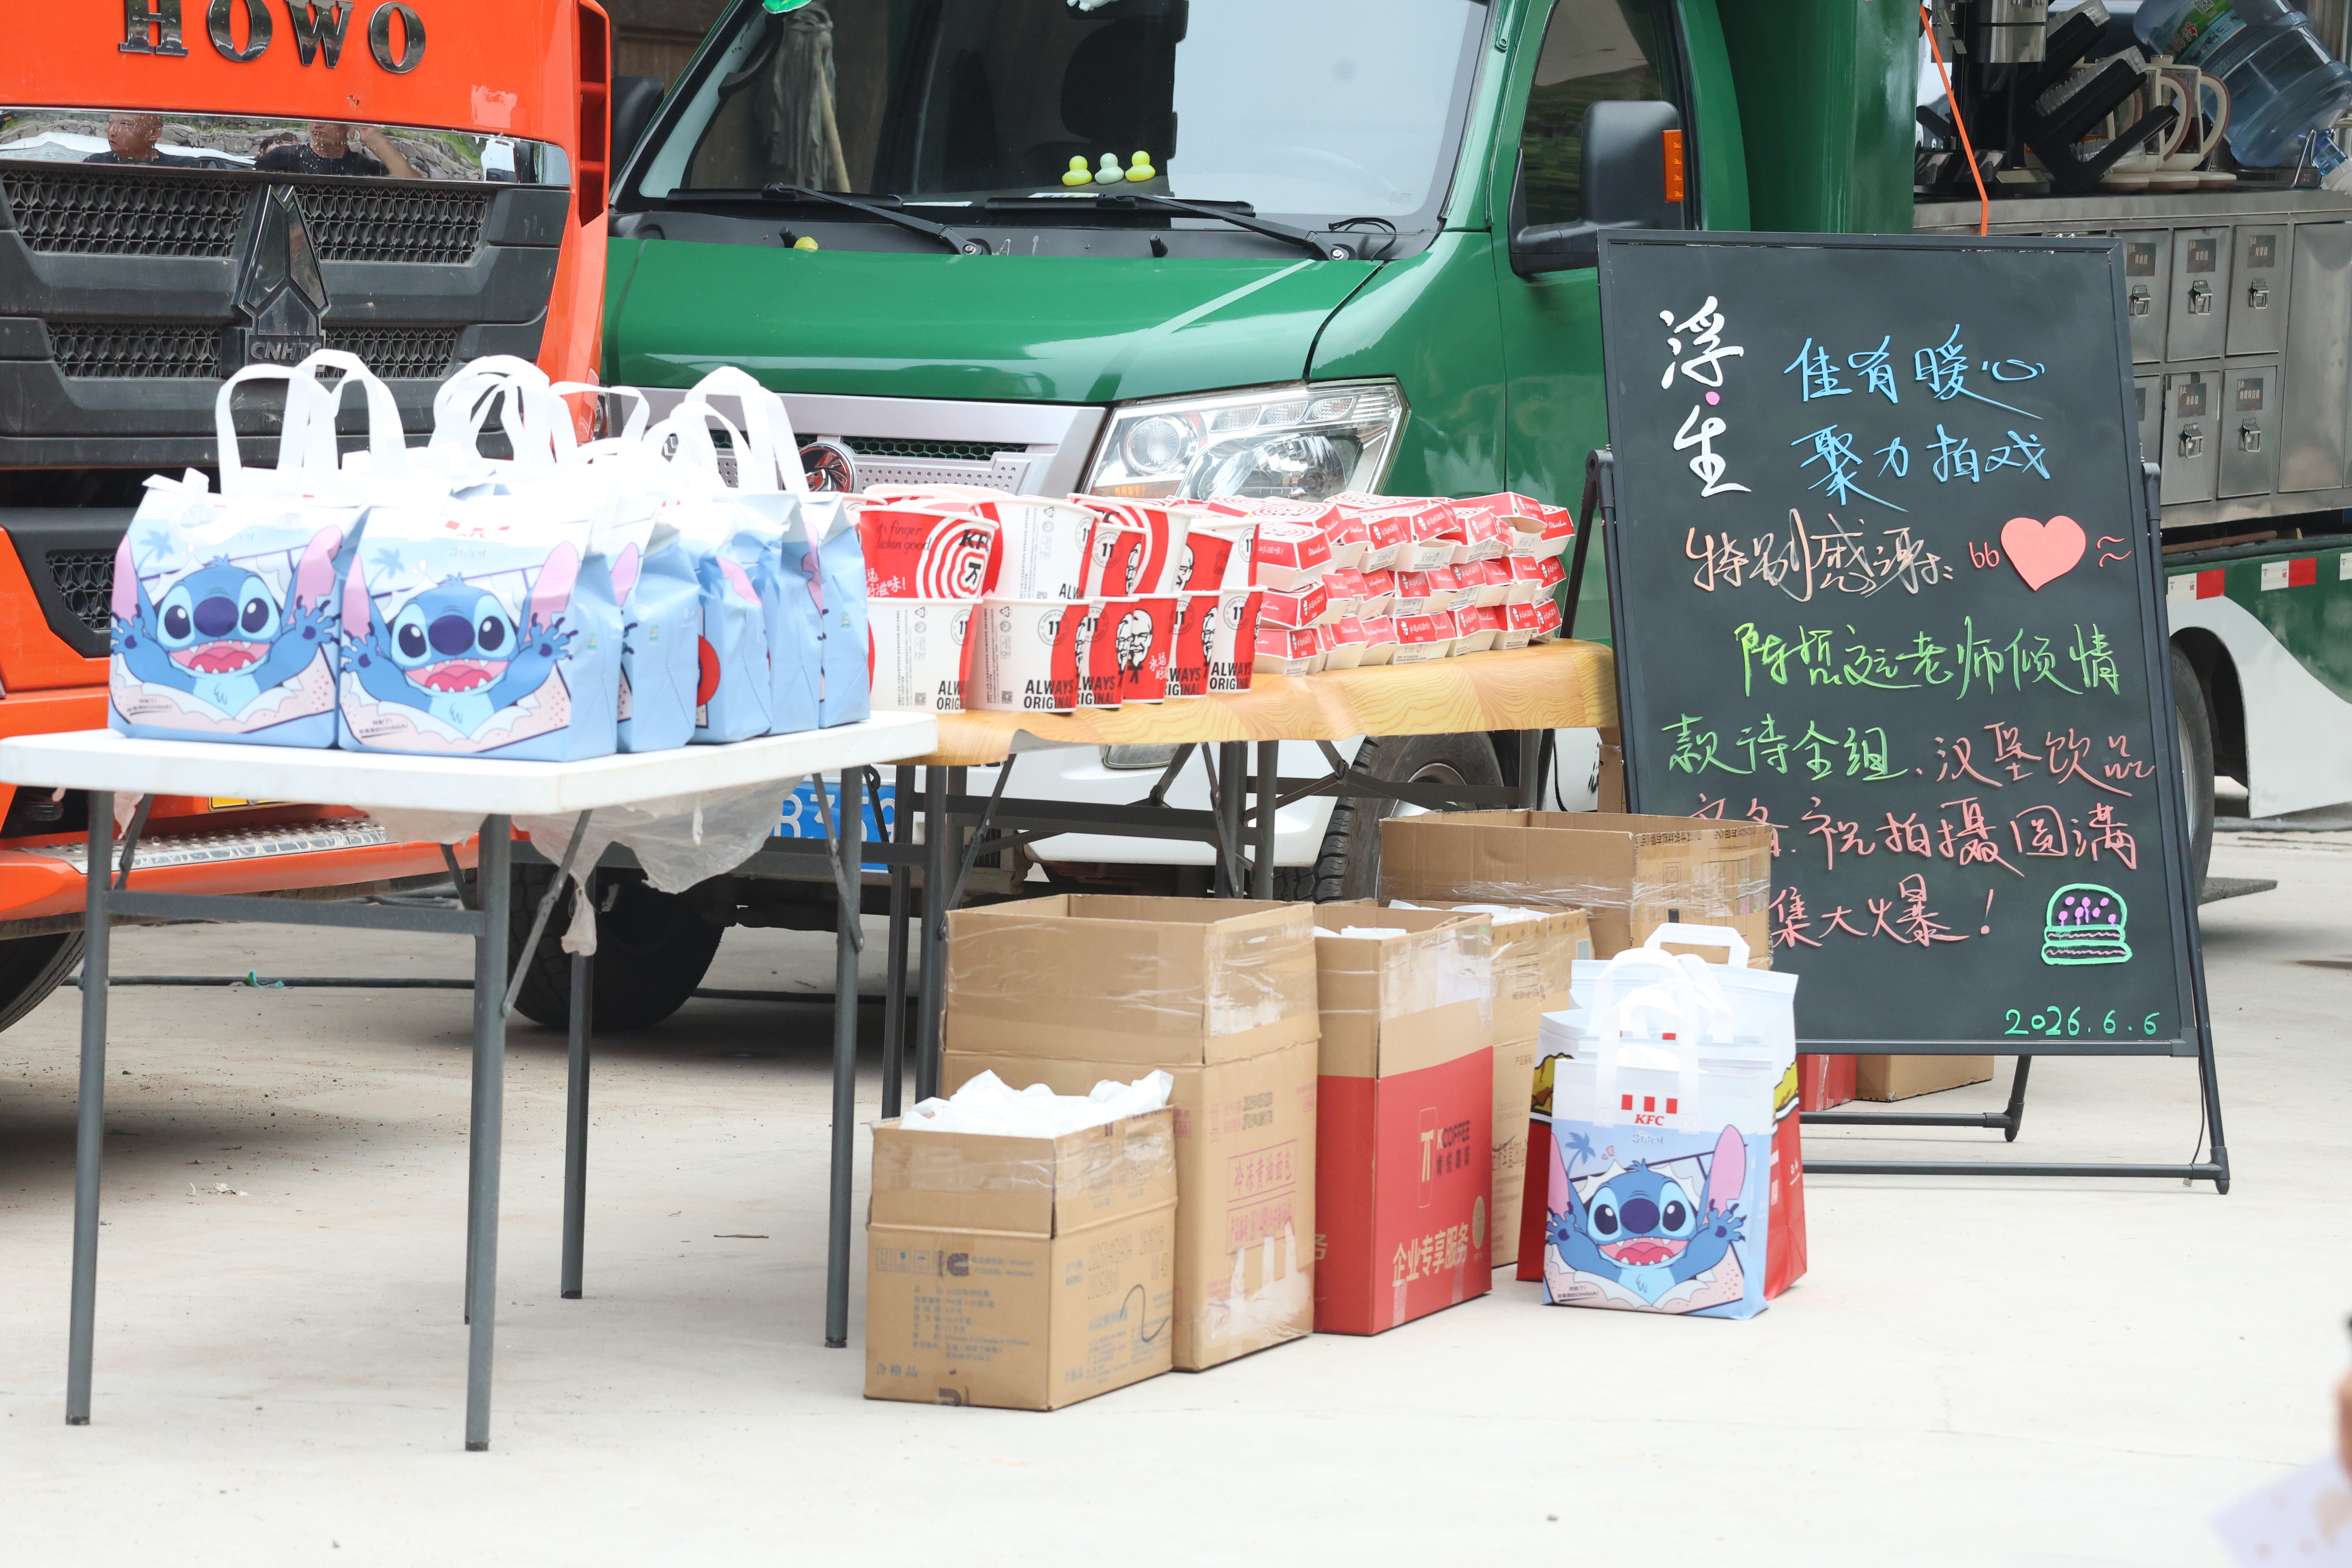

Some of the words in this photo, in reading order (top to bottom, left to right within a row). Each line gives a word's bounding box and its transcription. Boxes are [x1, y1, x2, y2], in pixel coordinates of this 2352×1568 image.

[119, 0, 426, 74] HOWO
[1790, 424, 2051, 512] 聚力拍戏
[1103, 543, 1114, 558] 11
[866, 567, 879, 583] 远
[1234, 606, 1245, 620] 11
[1049, 621, 1060, 635] 11
[1734, 617, 2119, 700] 陈哲远老师倾情
[1211, 662, 1252, 676] ALWAYS
[1025, 679, 1074, 695] ALWAYS
[1024, 695, 1073, 709] ORIGINAL
[2004, 1006, 2160, 1036] 2026.6.6
[1634, 1114, 1664, 1126] KFC
[1392, 1221, 1469, 1287] 企业专享服务
